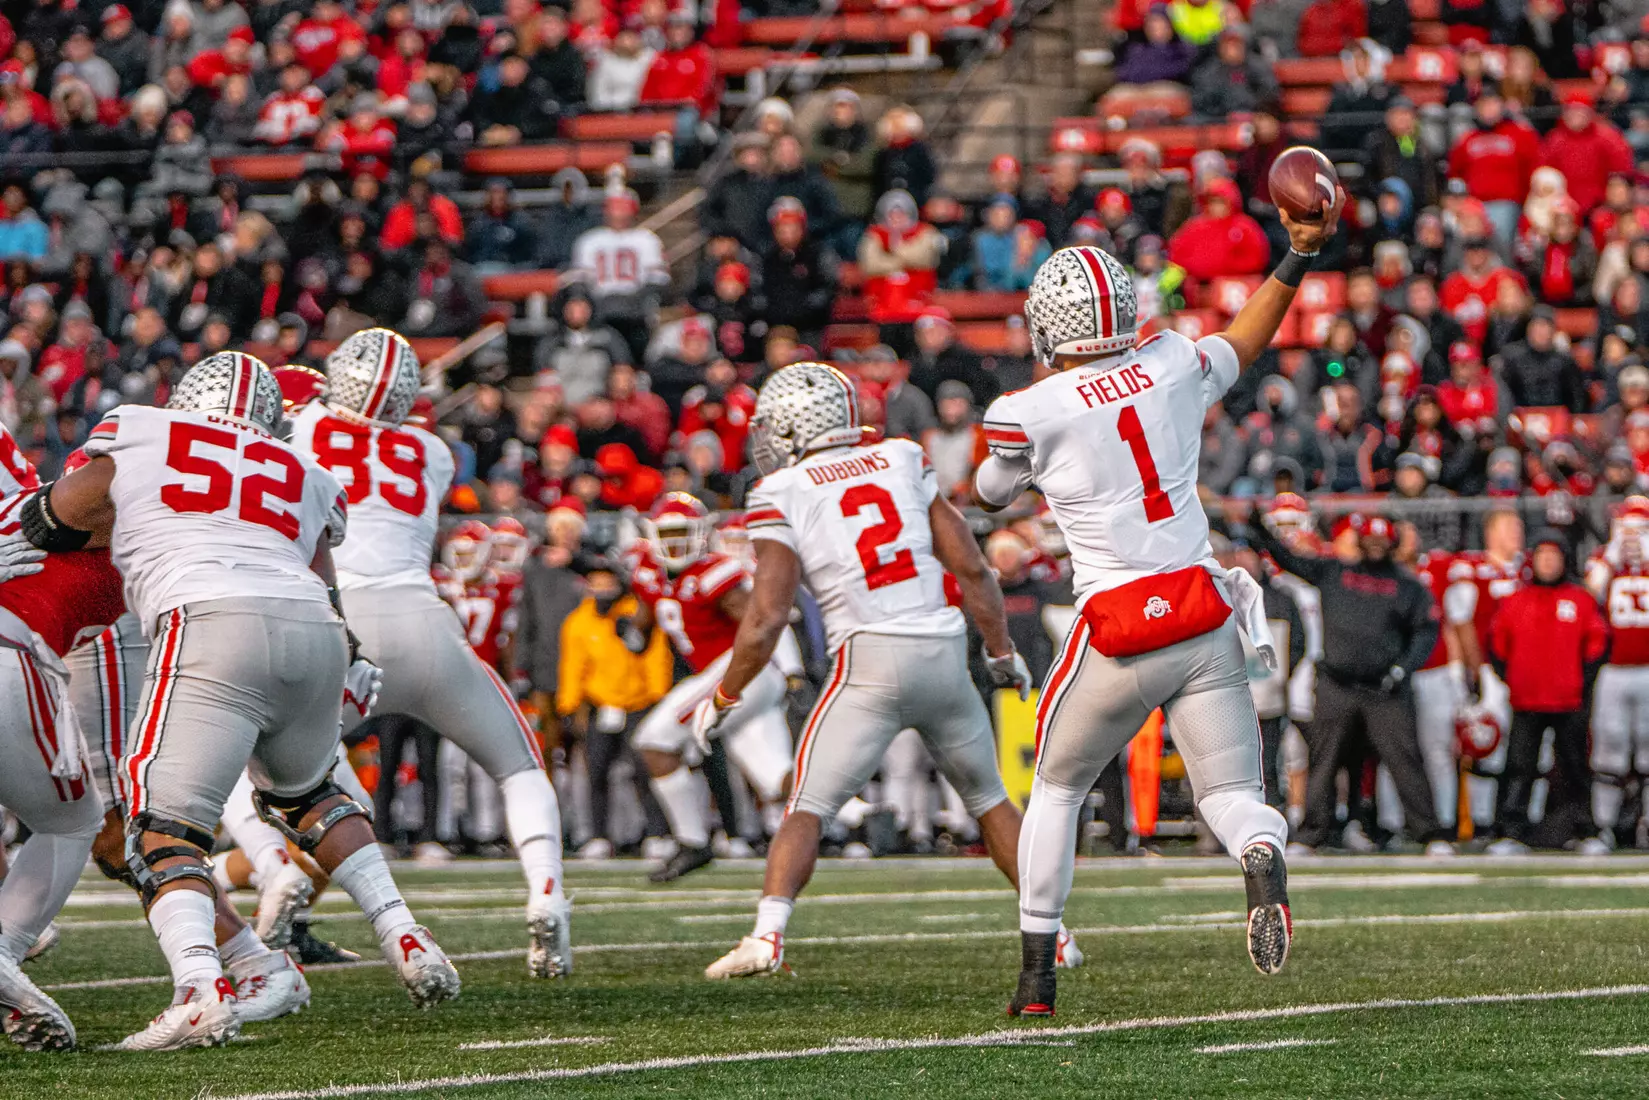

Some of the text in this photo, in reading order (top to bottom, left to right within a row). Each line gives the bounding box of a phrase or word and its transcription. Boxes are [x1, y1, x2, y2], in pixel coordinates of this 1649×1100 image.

[1076, 363, 1154, 408] FIELDS
[162, 420, 305, 542] 52
[313, 416, 428, 517] 89
[806, 451, 890, 485] DOBBINS
[1117, 404, 1175, 523] 1
[839, 482, 919, 591] 2
